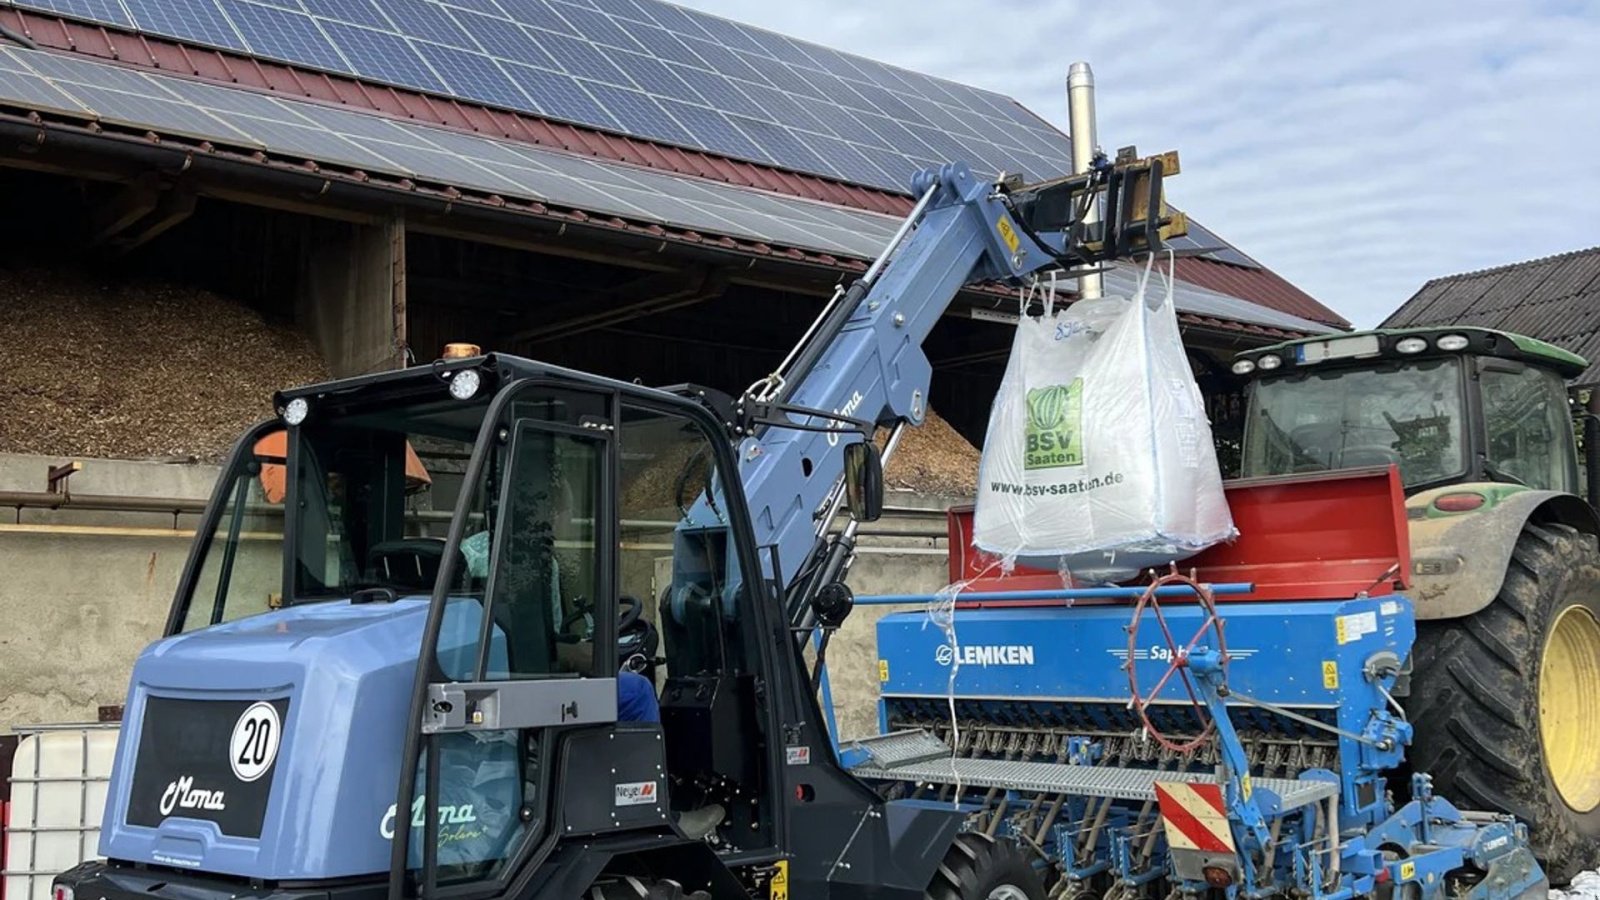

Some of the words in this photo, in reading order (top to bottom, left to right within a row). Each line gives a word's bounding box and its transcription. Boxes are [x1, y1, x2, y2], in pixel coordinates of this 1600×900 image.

[1027, 430, 1073, 452] BSV
[1027, 452, 1076, 465] Saaten
[955, 645, 1034, 665] LEMKEN
[238, 717, 271, 766] 20
[160, 775, 226, 816] Mona
[380, 794, 477, 839] Mna
